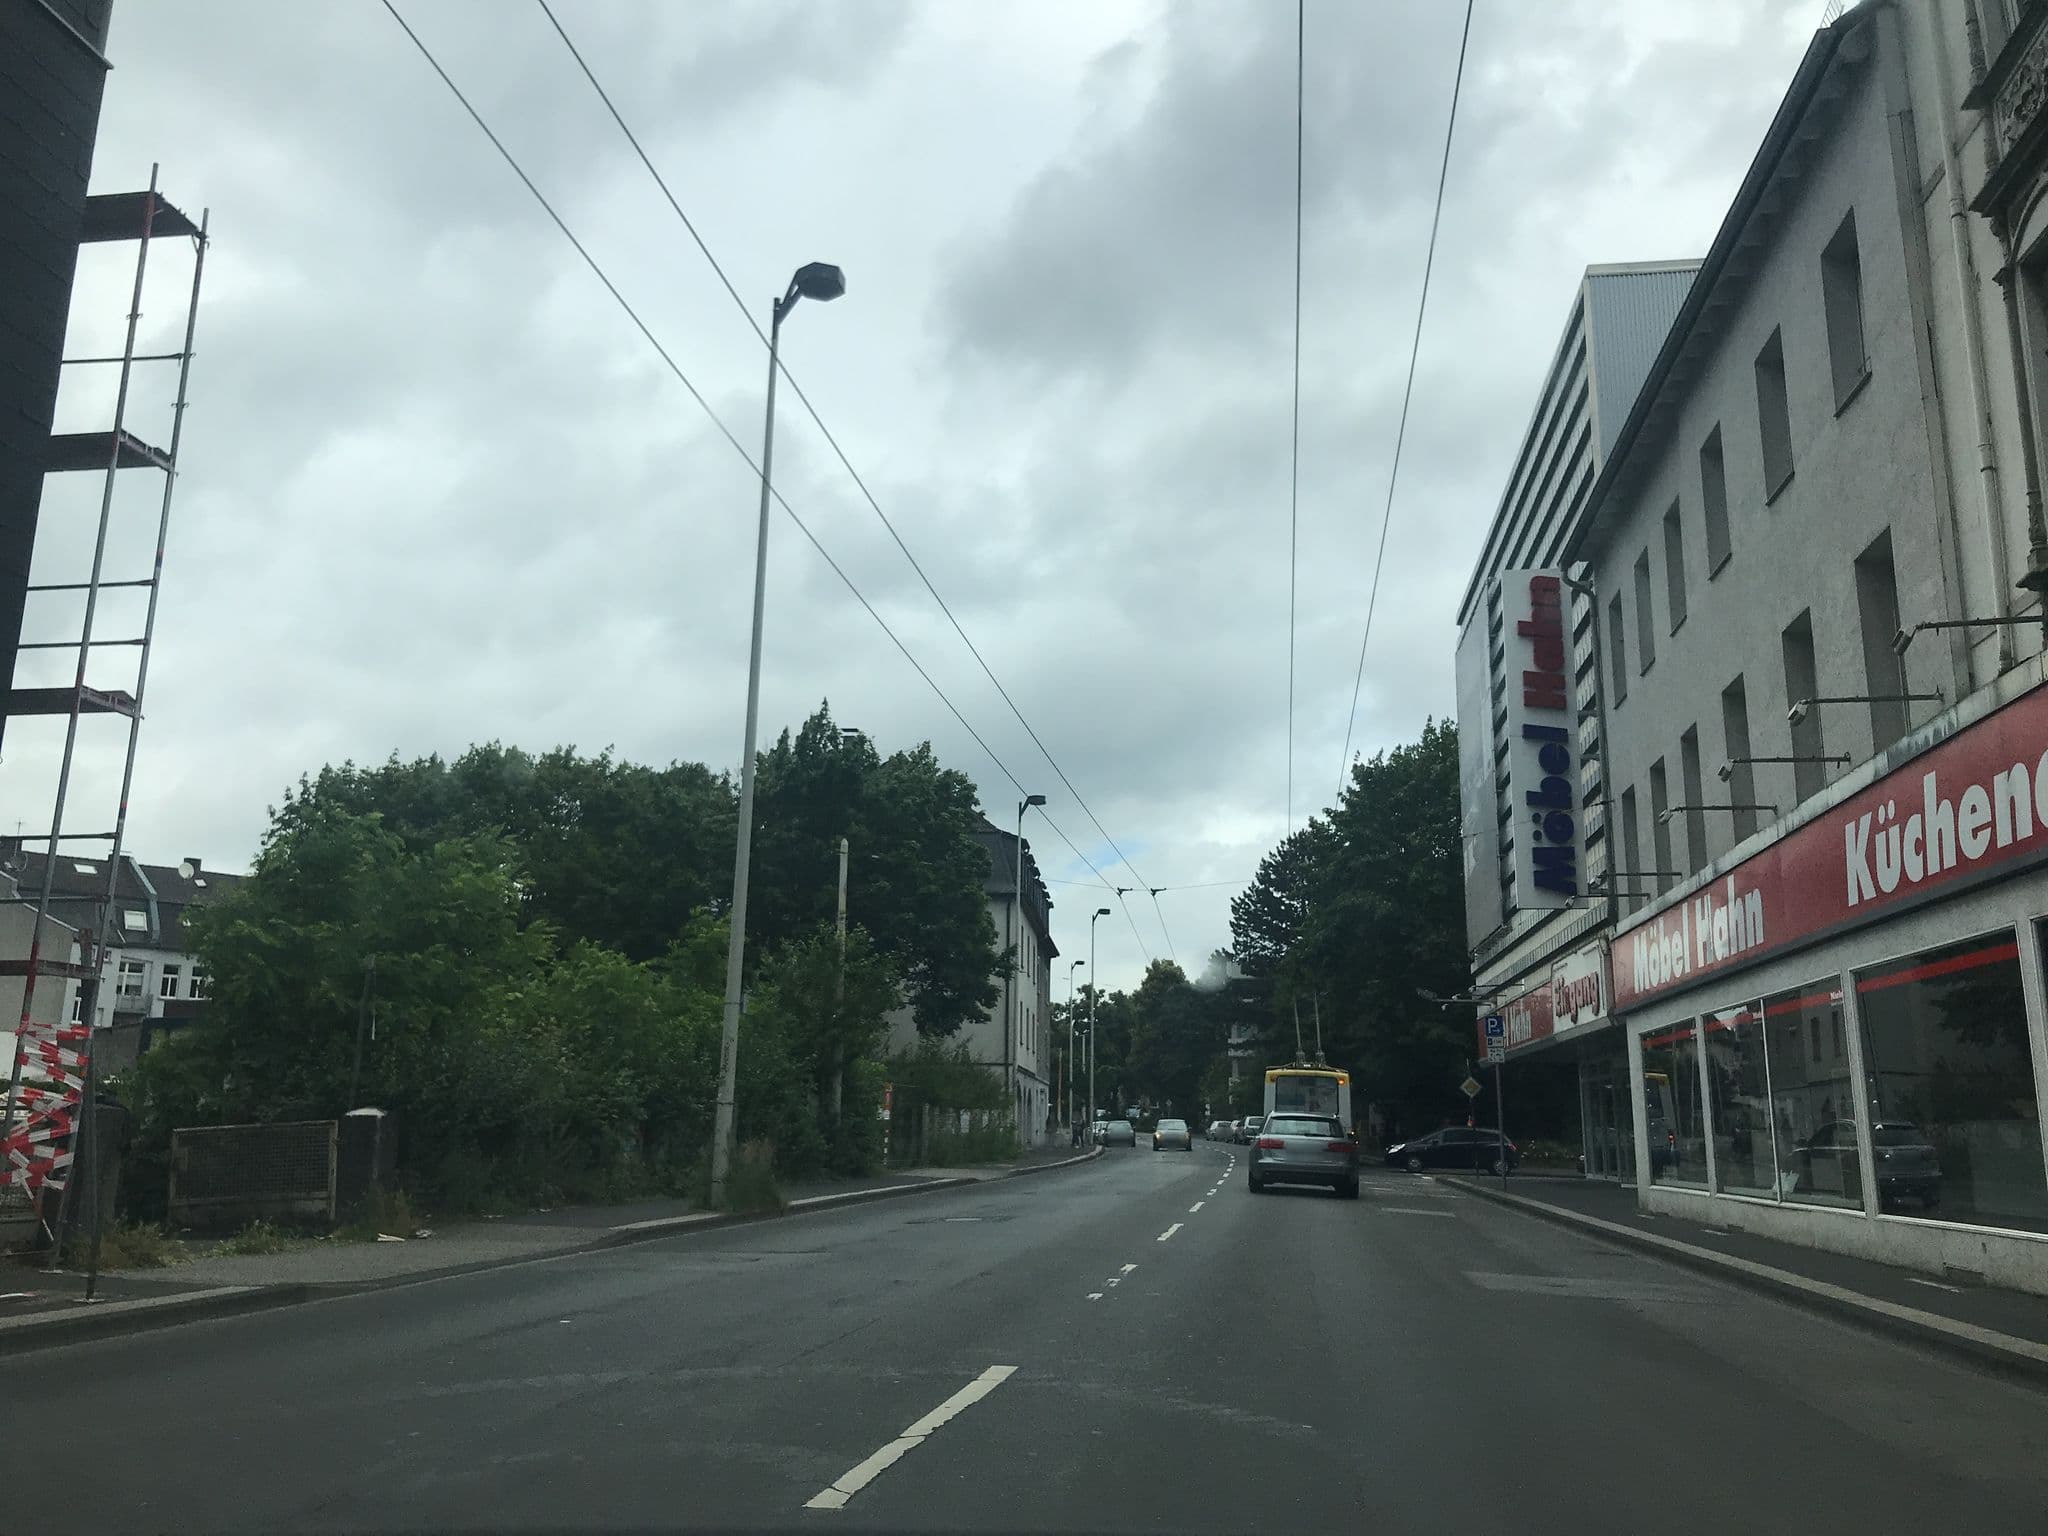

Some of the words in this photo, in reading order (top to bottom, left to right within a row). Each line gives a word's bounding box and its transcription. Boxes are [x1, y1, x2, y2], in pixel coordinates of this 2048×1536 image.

[1517, 576, 1567, 709] Hahn
[1522, 723, 1577, 897] Möbel
[1633, 902, 1691, 994] Möbel
[1695, 874, 1764, 968] Hahn
[1487, 1018, 1498, 1034] P
